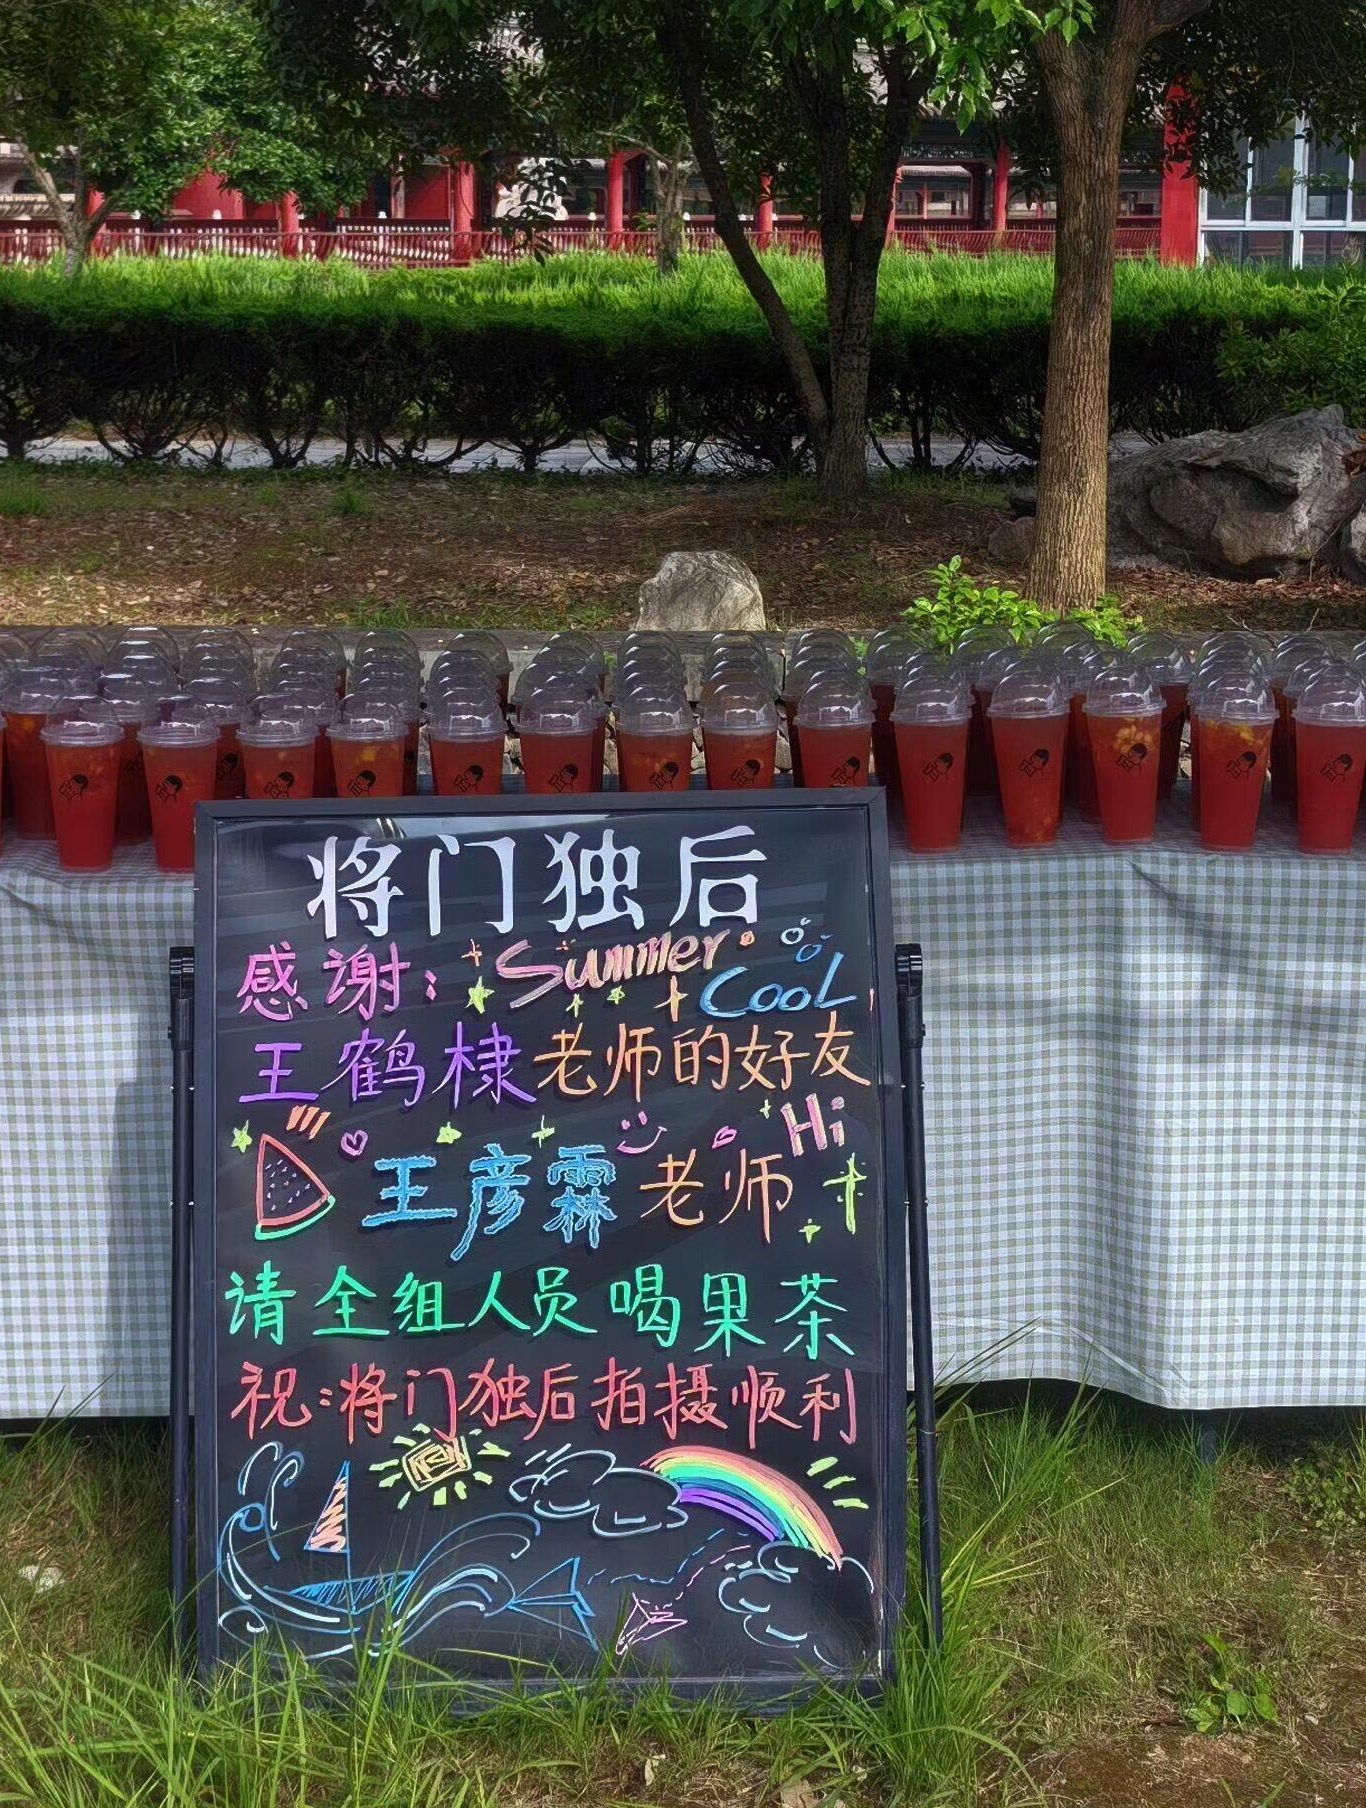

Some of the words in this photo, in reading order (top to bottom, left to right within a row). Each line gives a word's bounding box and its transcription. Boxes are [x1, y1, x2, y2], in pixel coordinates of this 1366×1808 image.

[306, 826, 768, 939] 将门独后
[496, 929, 730, 1009] Summer
[781, 1094, 846, 1157] Hi
[225, 1260, 855, 1360] 请全组人员喝果茶
